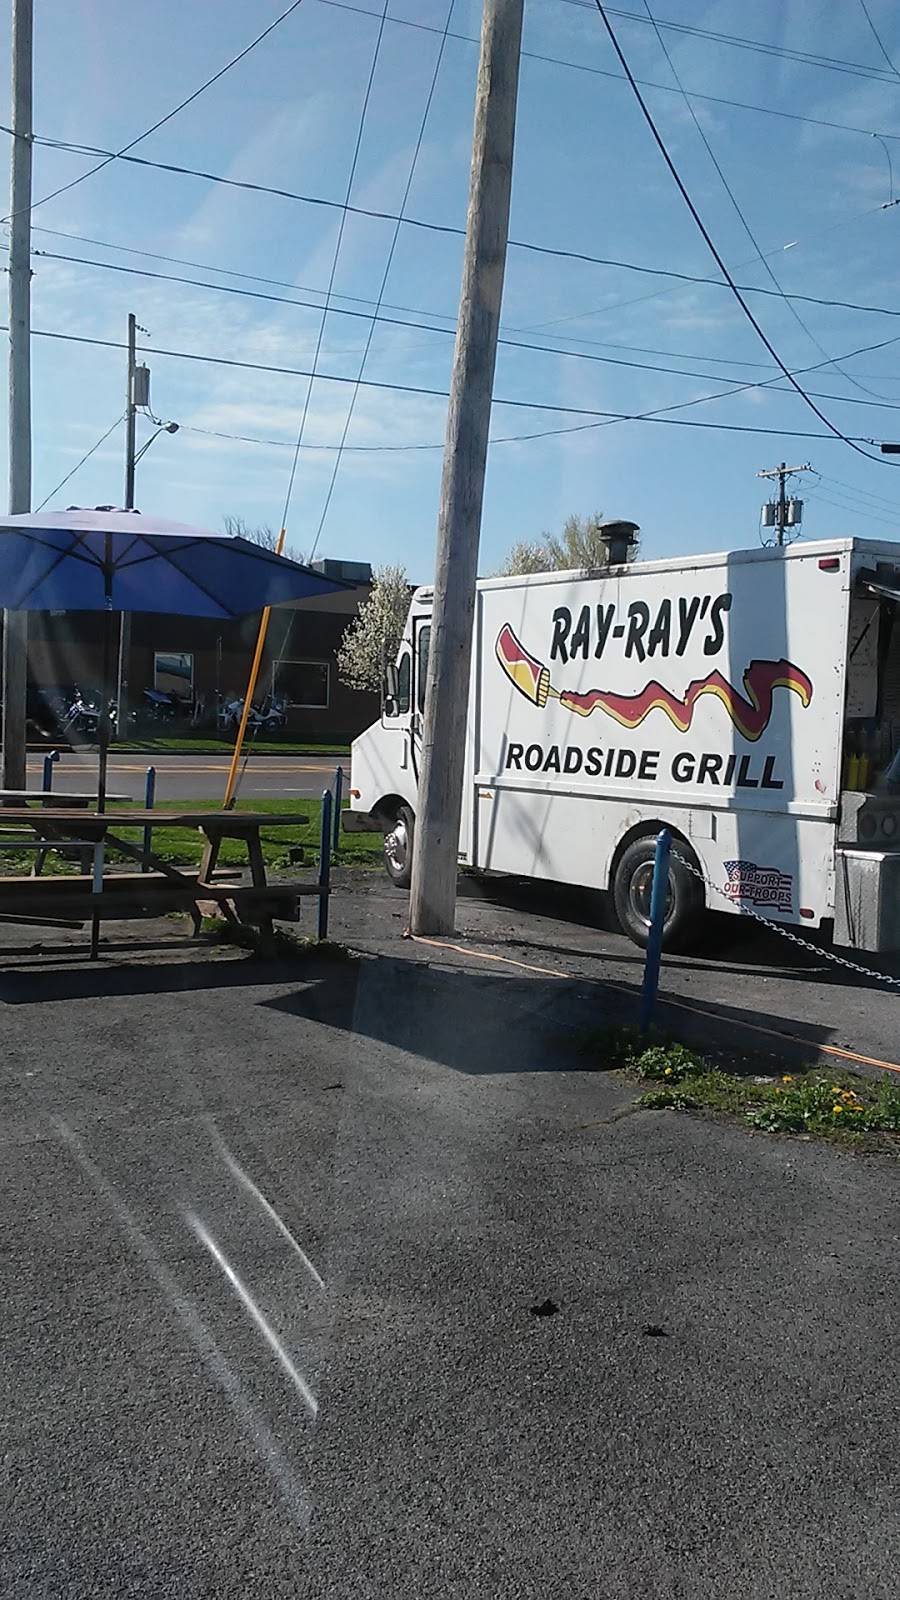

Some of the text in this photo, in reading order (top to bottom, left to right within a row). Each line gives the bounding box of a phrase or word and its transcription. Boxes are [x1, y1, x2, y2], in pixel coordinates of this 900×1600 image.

[550, 593, 733, 664] RAY-RAY'S
[505, 743, 785, 789] ROADSIDE GRILL
[724, 882, 792, 903] OUR TROOPS
[733, 871, 783, 887] SUPPORT
